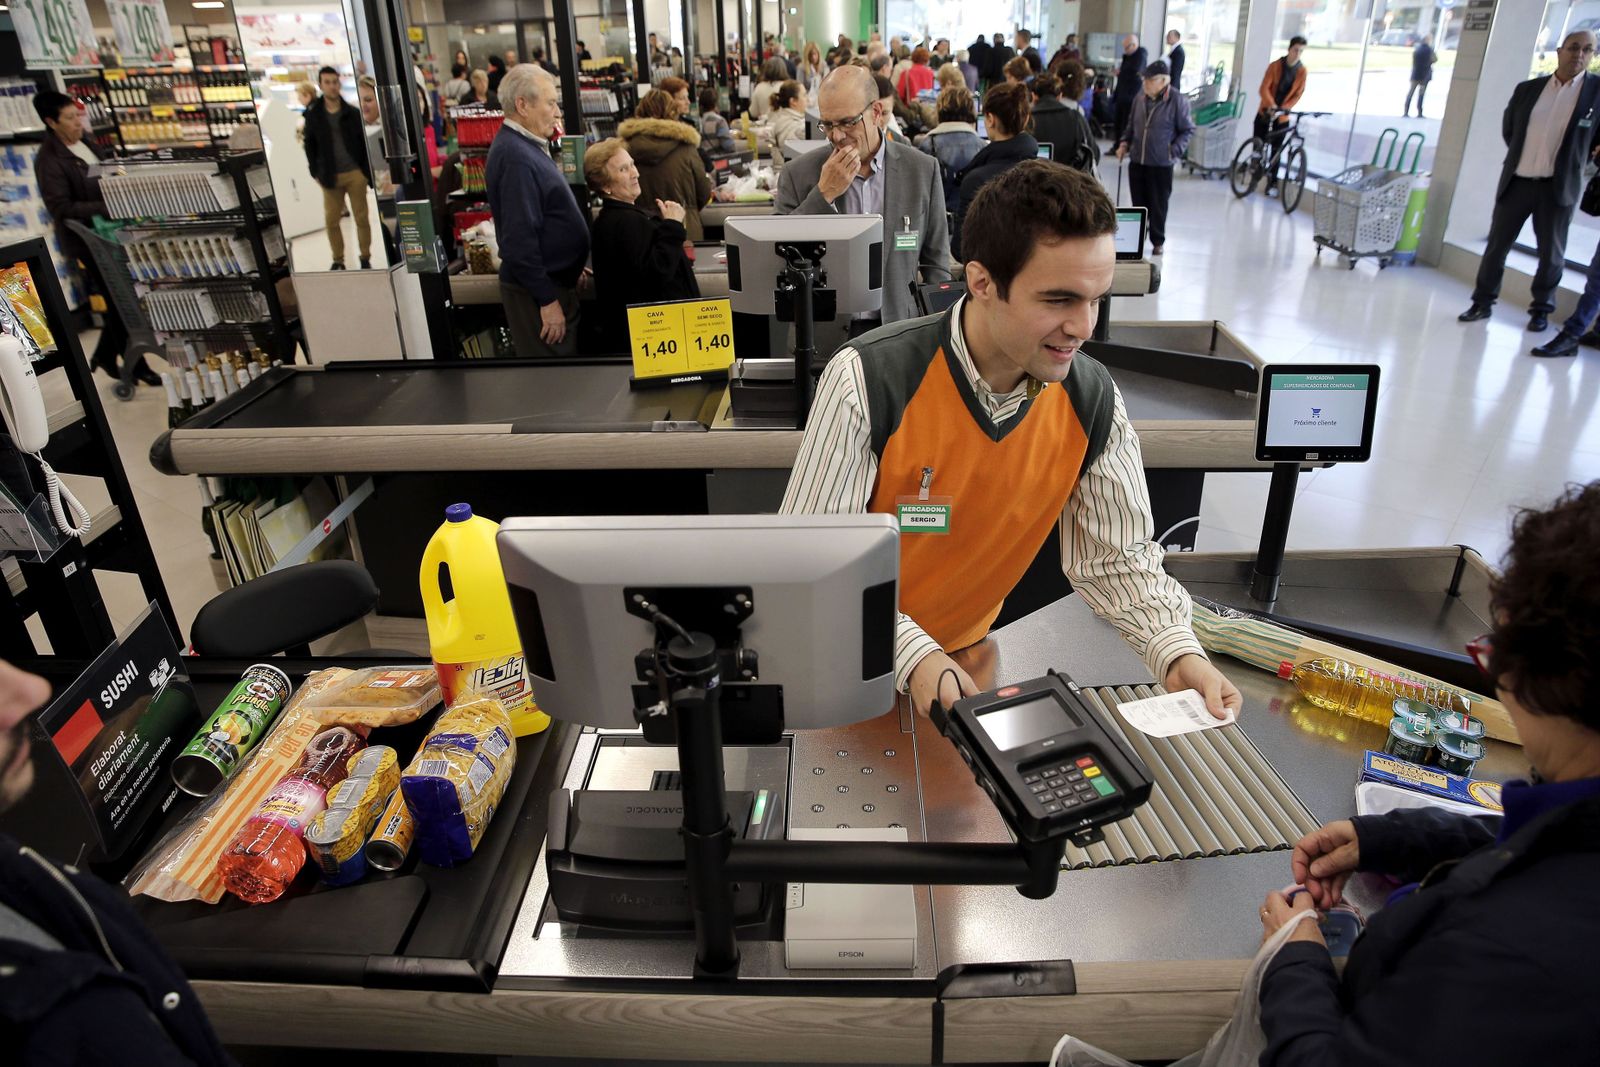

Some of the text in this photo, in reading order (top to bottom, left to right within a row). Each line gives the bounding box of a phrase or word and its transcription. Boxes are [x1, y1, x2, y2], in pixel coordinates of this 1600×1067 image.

[641, 340, 677, 359] 1,40
[695, 334, 730, 352] 1,40
[101, 660, 139, 709] SUSHI
[91, 730, 126, 777] Elaborat
[98, 733, 140, 790] diariament
[110, 805, 121, 821] Ara
